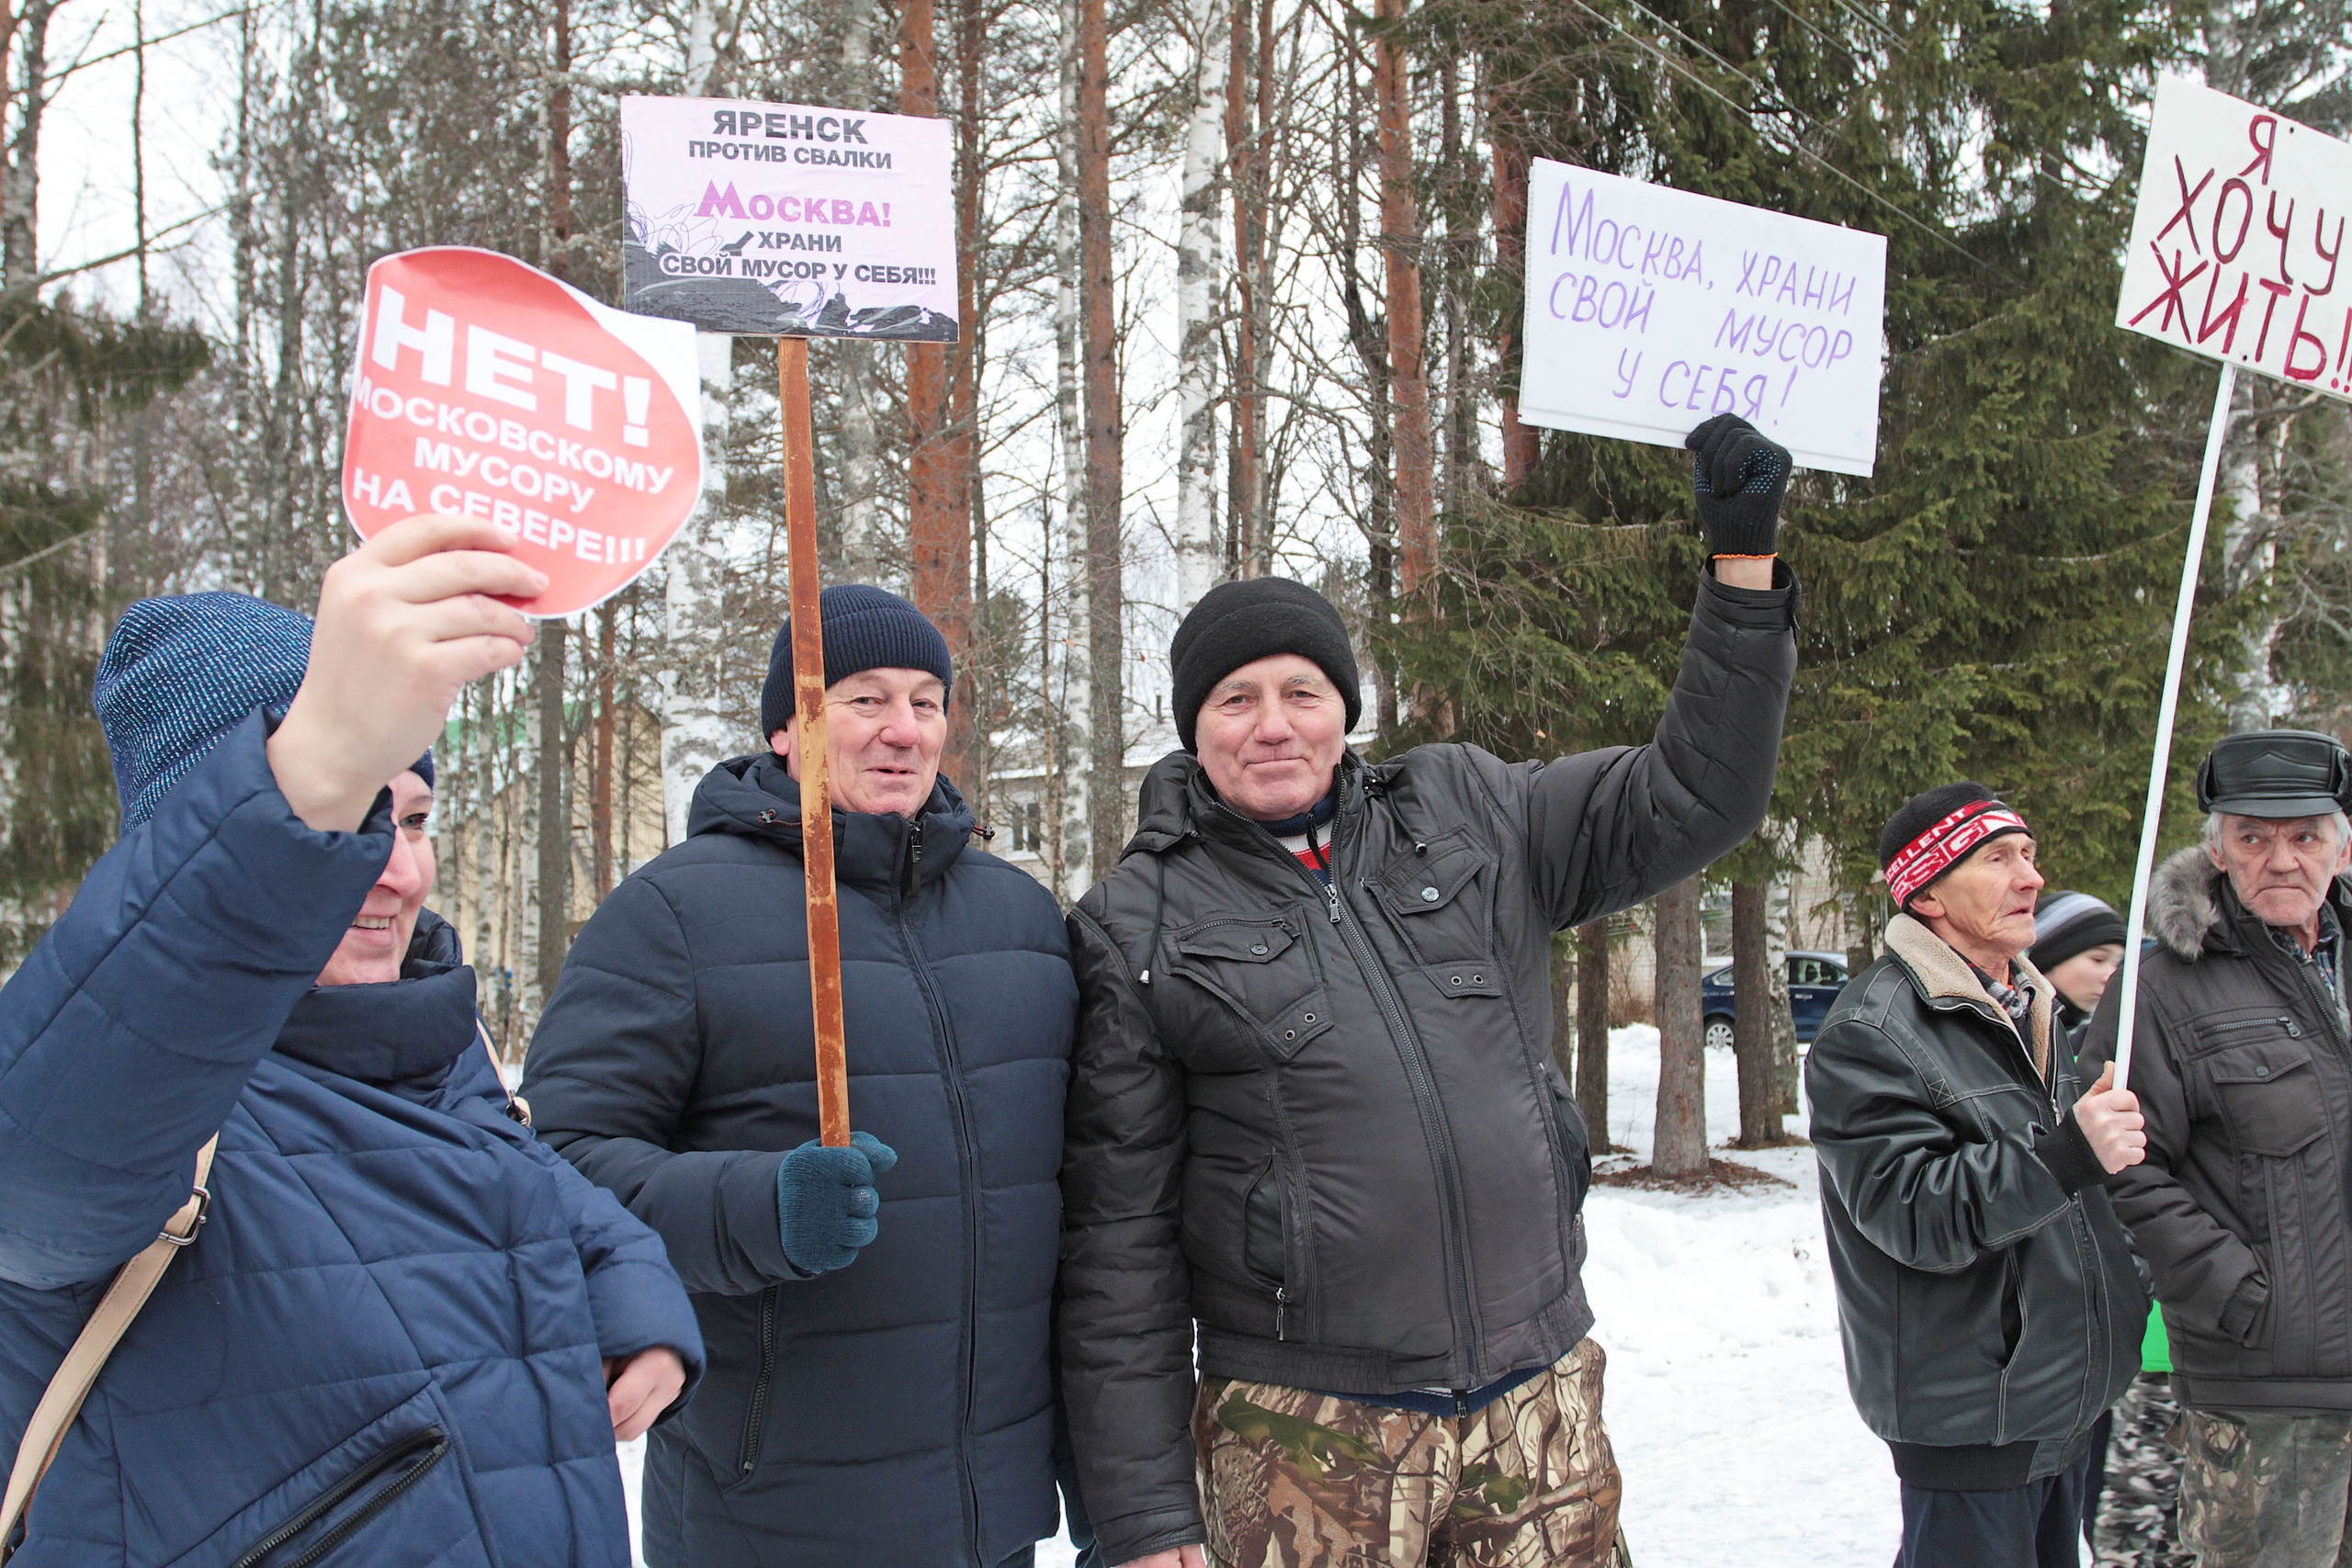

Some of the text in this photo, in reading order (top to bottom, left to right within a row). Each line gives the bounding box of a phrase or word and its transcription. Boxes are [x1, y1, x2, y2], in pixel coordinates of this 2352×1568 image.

[689, 140, 892, 169] ПРОТИВ СВАЛКИ
[712, 109, 868, 144] ЯРЕНСК
[2238, 114, 2278, 186] Я
[757, 231, 842, 253] ХРАНИ
[2156, 153, 2345, 296] ХОЧУ
[663, 252, 936, 286] СВОЙ МУСОР У СЕБЯ!!!
[1736, 249, 1856, 316] ХРАНИ
[1549, 271, 1853, 369] СВОЙ МУСОР
[371, 284, 651, 448] НЕТ!
[1612, 347, 1798, 426] У СЕБЯ!
[413, 437, 594, 513] МУСОРУ
[353, 467, 646, 564] НА СЕВЕРЕ!!!
[1891, 809, 2028, 908] ESIGN
